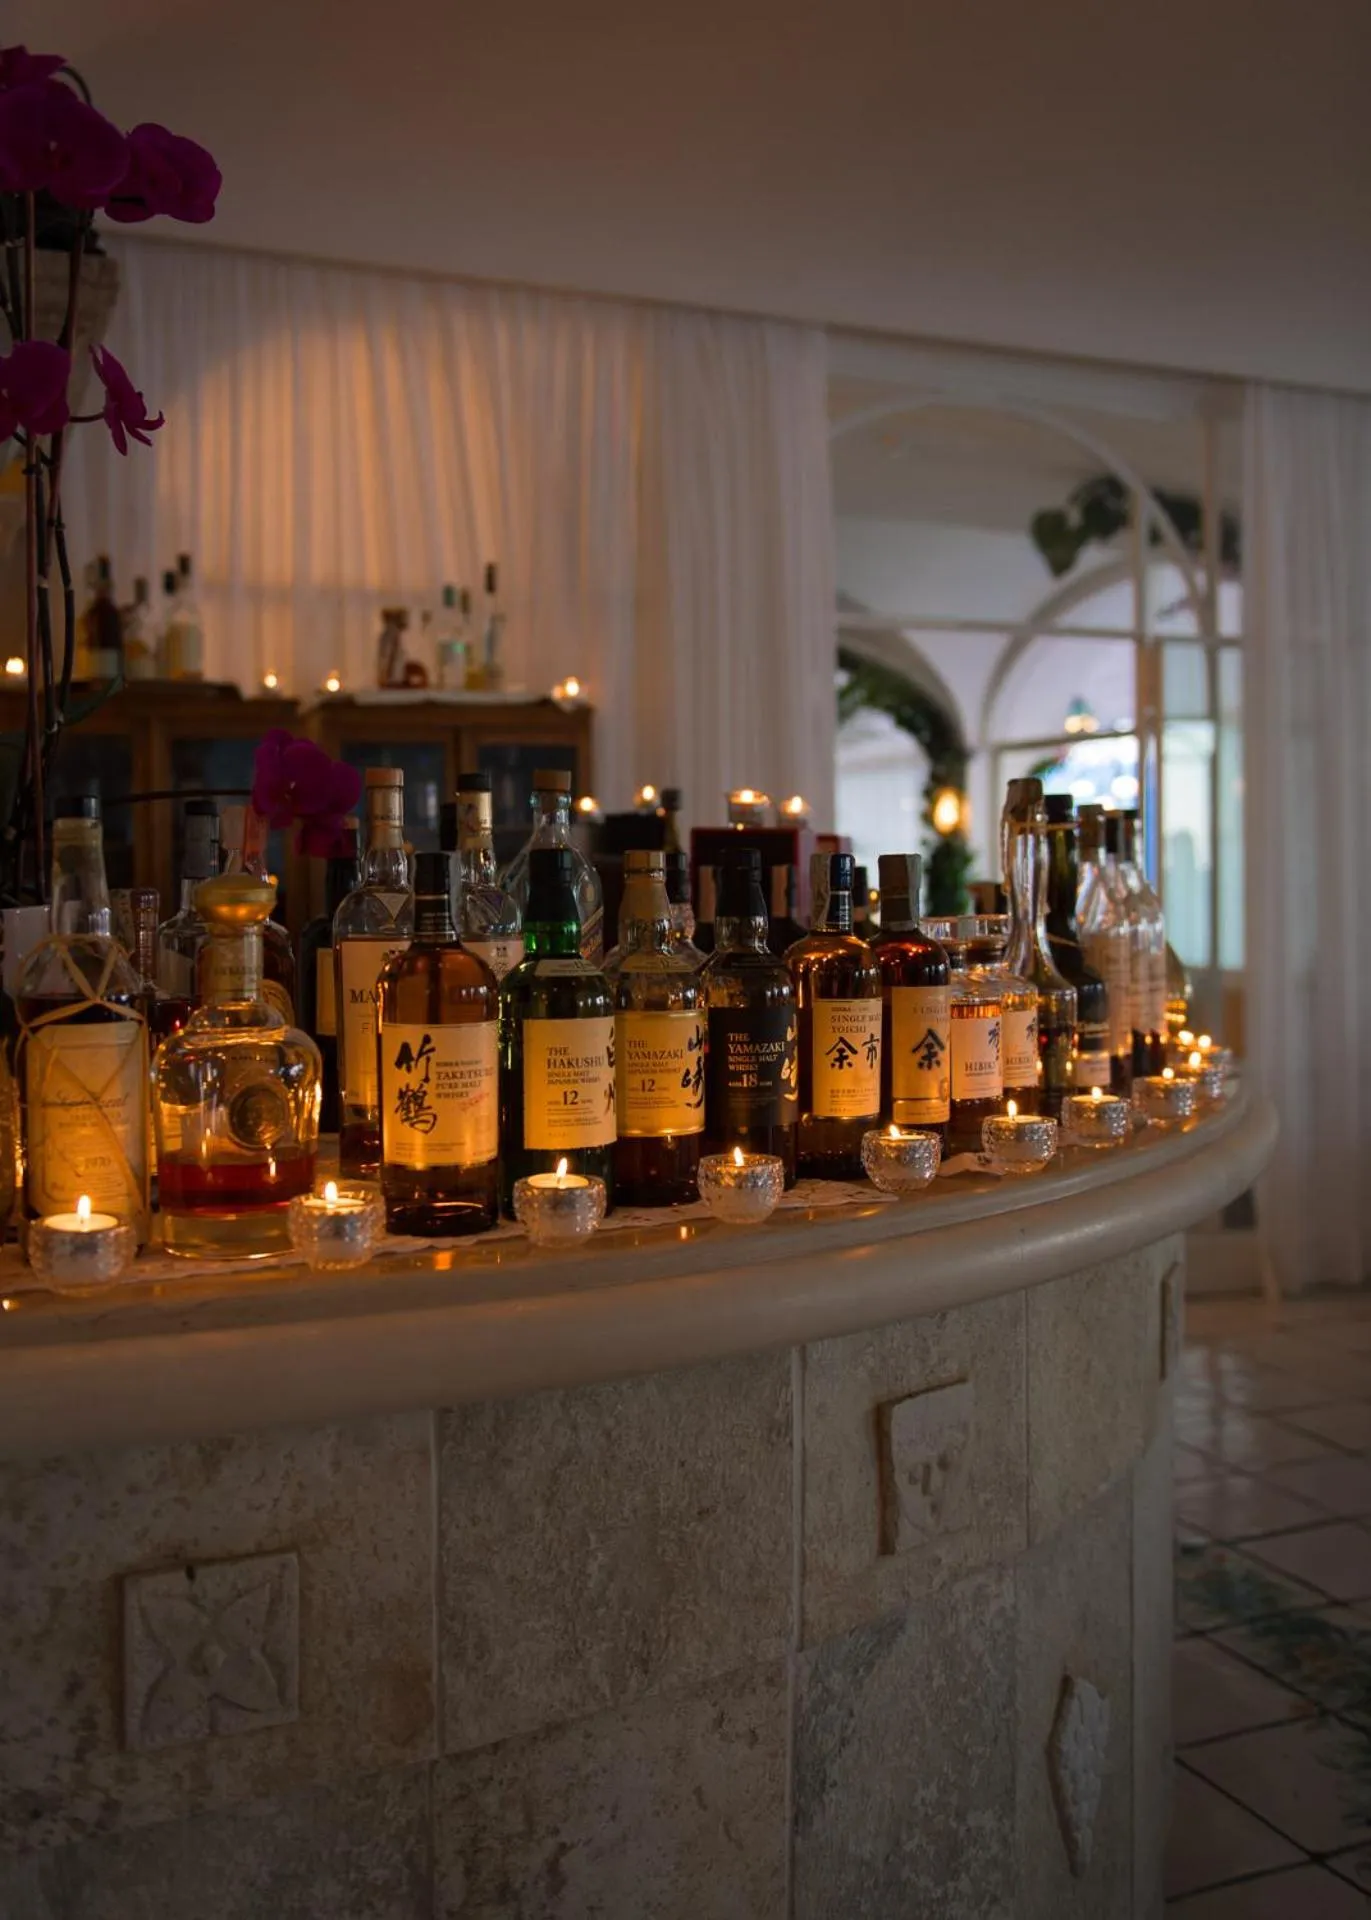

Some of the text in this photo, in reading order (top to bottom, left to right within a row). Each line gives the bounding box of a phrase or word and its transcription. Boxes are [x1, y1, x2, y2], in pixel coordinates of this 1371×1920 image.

[831, 1014, 866, 1023] SINGLE
[728, 1033, 749, 1041] THE
[627, 1040, 647, 1048] THE
[728, 1041, 785, 1054] YAMAZAKI
[546, 1046, 569, 1056] THE
[627, 1048, 683, 1060] YAMAZAKI
[547, 1056, 604, 1069] HAKUSHU
[641, 1079, 656, 1092] 12
[742, 1073, 757, 1087] 18
[563, 1090, 579, 1105] 12
